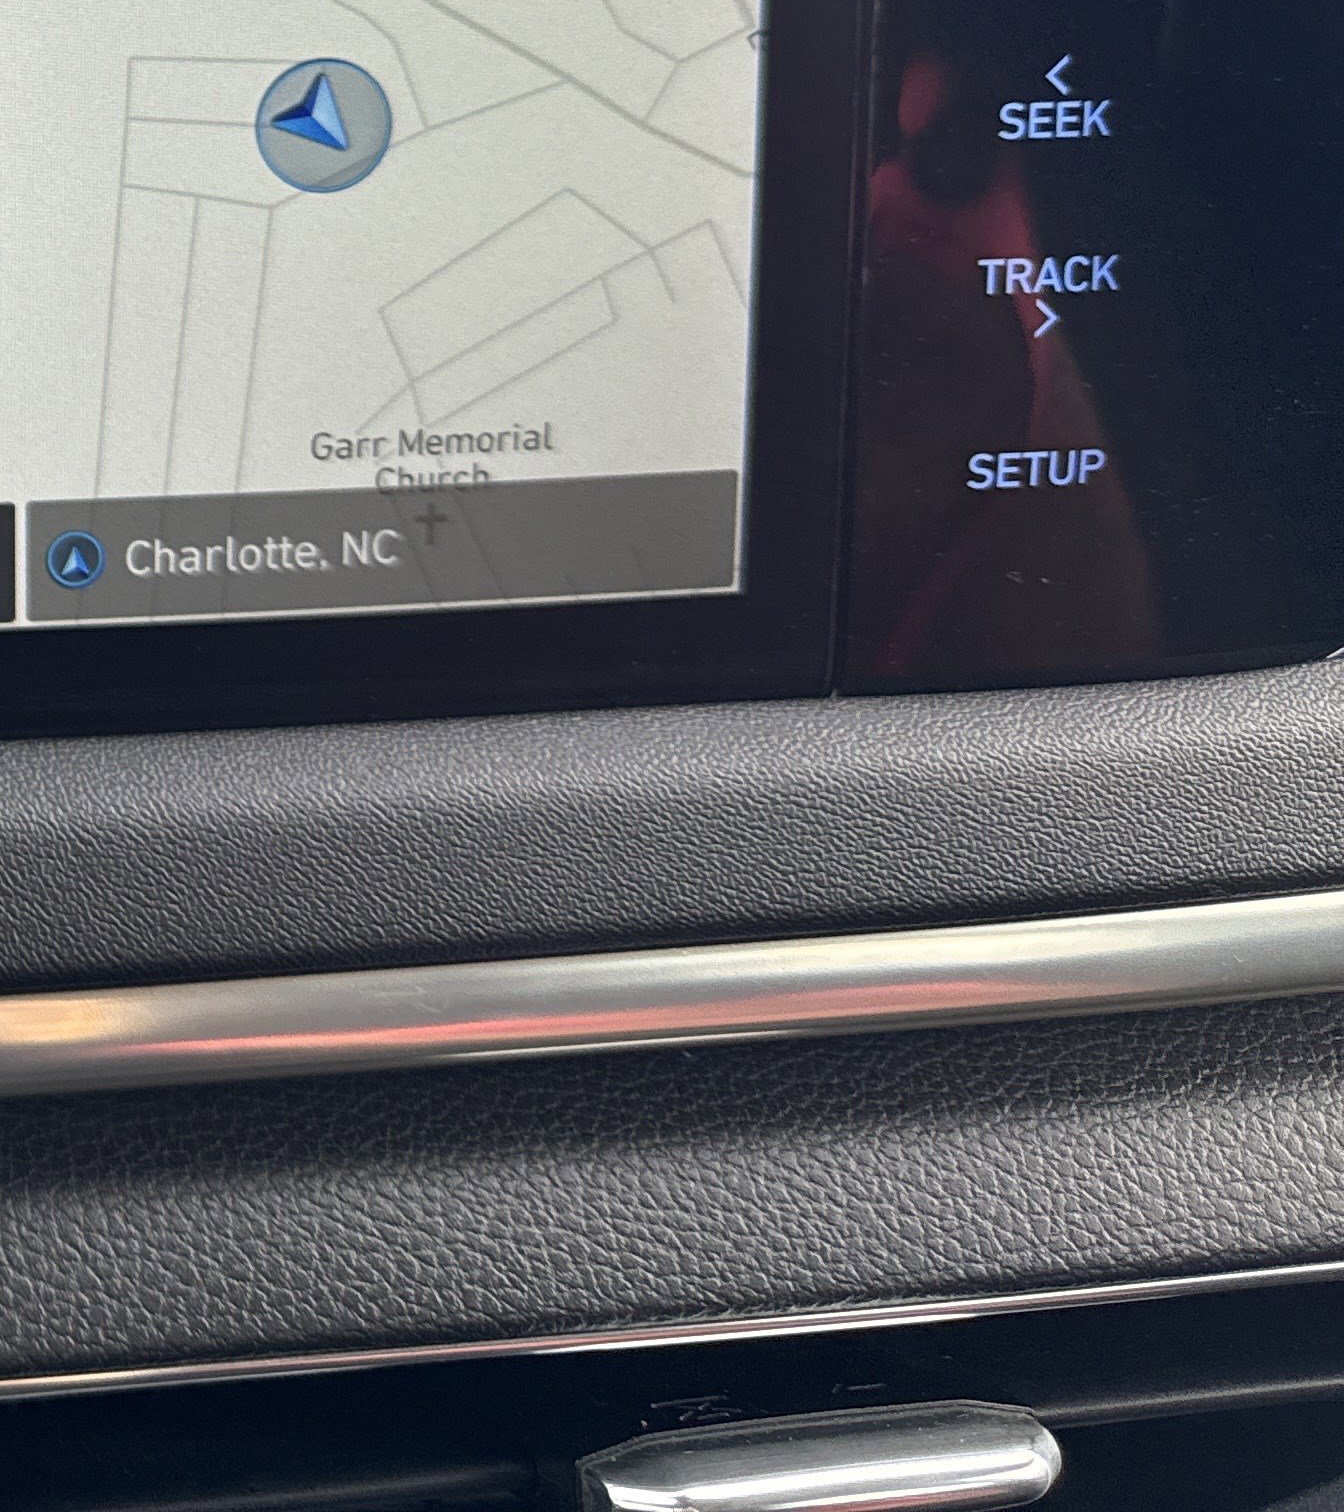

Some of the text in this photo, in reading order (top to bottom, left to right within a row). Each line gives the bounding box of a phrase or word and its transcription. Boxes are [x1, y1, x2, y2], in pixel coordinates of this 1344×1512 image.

[997, 99, 1113, 141] SEEK
[977, 254, 1121, 295] TRACK
[311, 421, 554, 461] Garr Memorial
[375, 461, 491, 495] Church
[966, 448, 1107, 490] SETUP
[341, 529, 404, 566] NC
